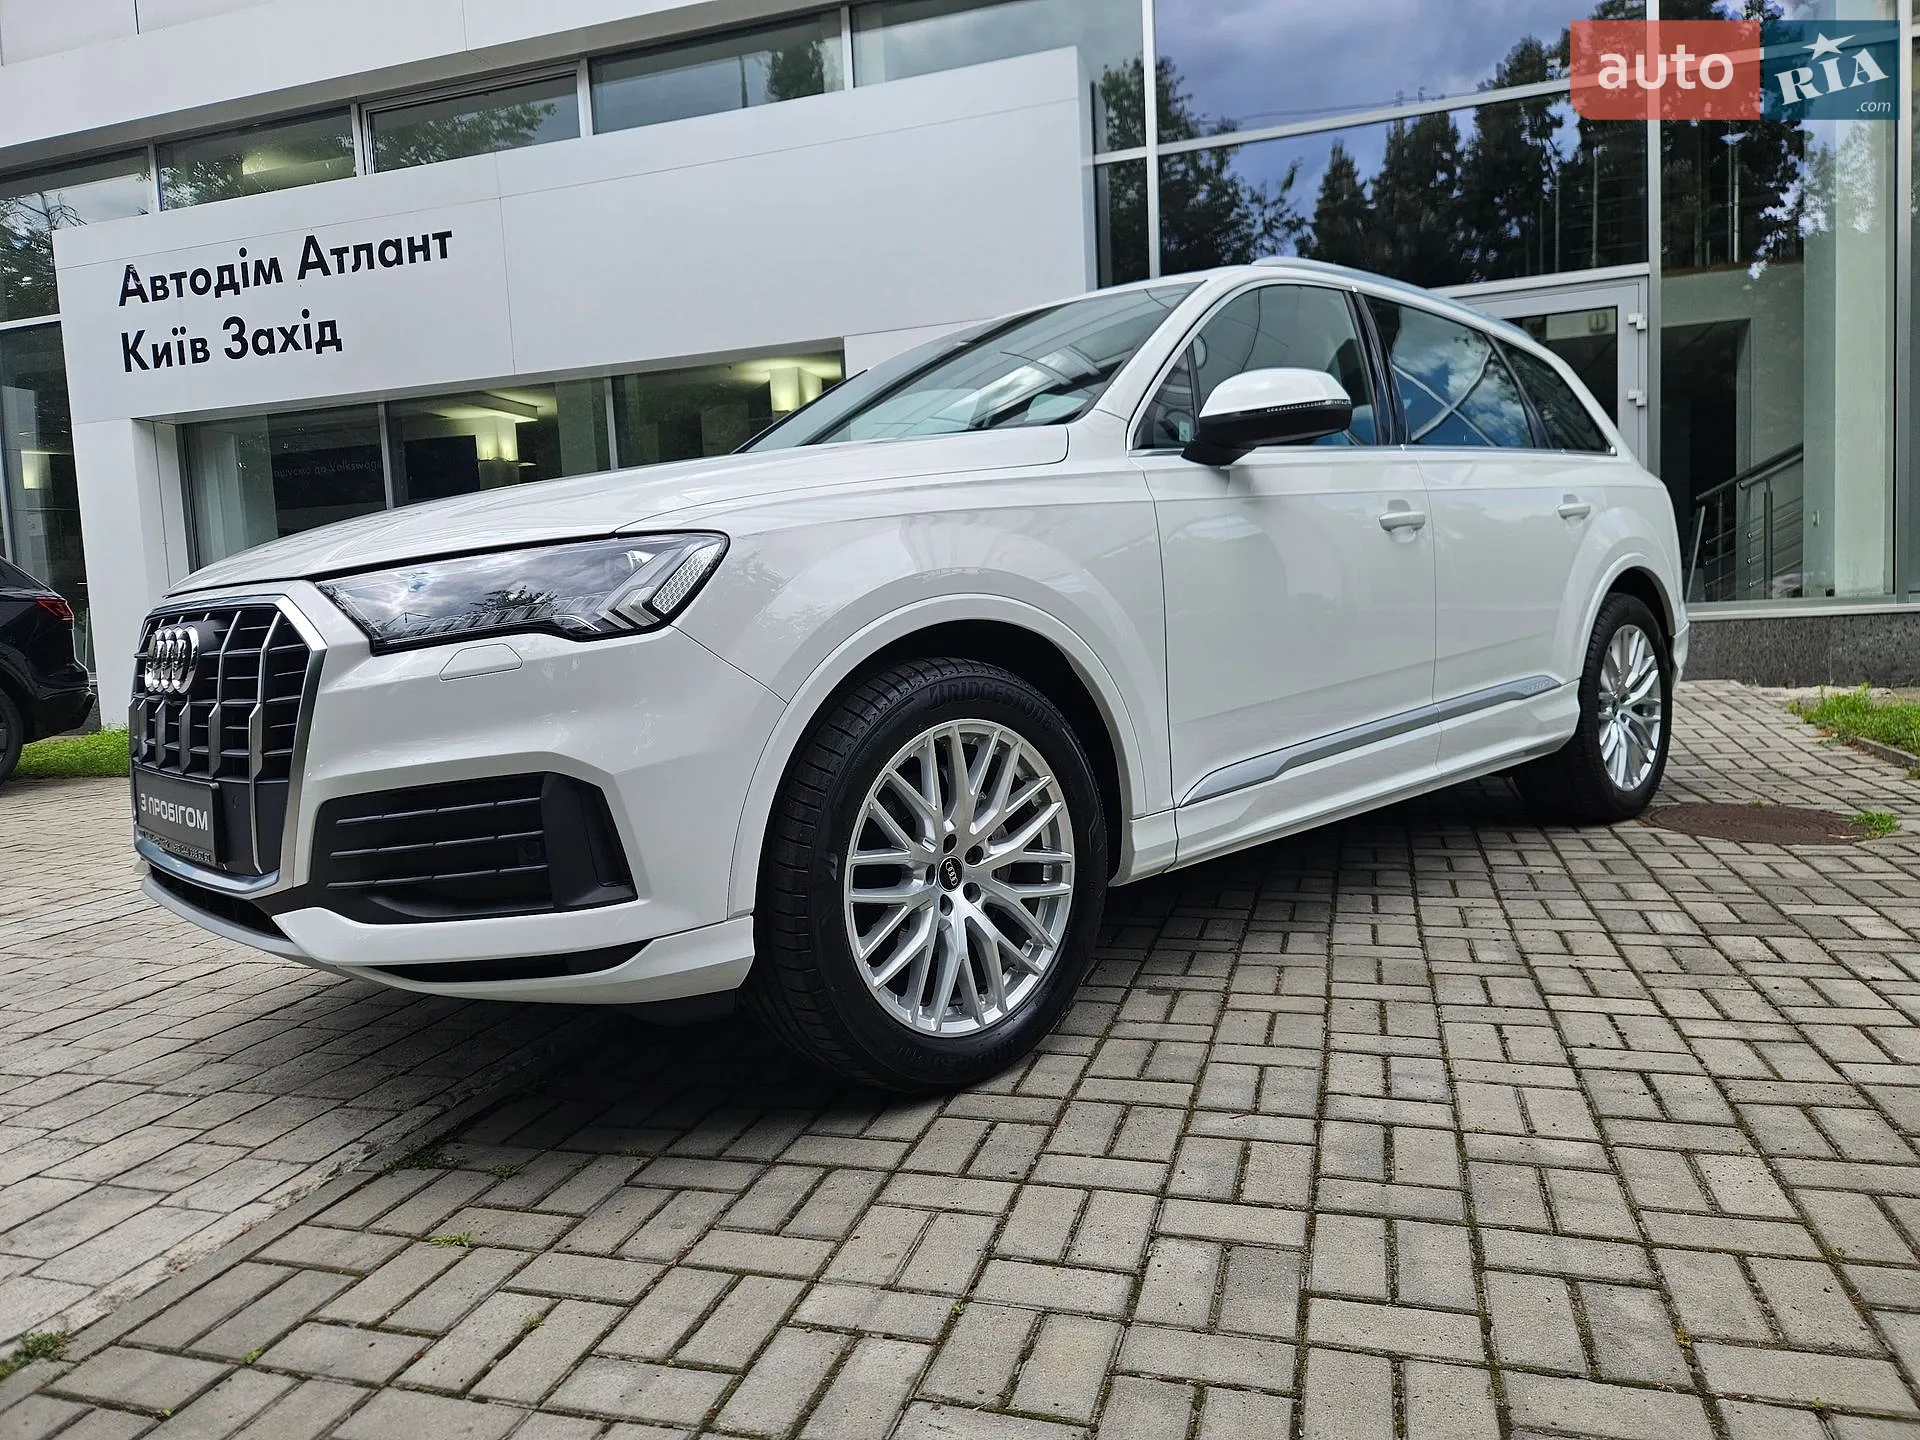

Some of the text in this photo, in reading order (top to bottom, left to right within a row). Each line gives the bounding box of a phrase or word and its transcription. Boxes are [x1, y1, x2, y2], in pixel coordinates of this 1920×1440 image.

[118, 230, 453, 307] Автодім Атлант
[121, 308, 343, 373] Київ Захід
[149, 796, 208, 831] ПРОБІГОМ
